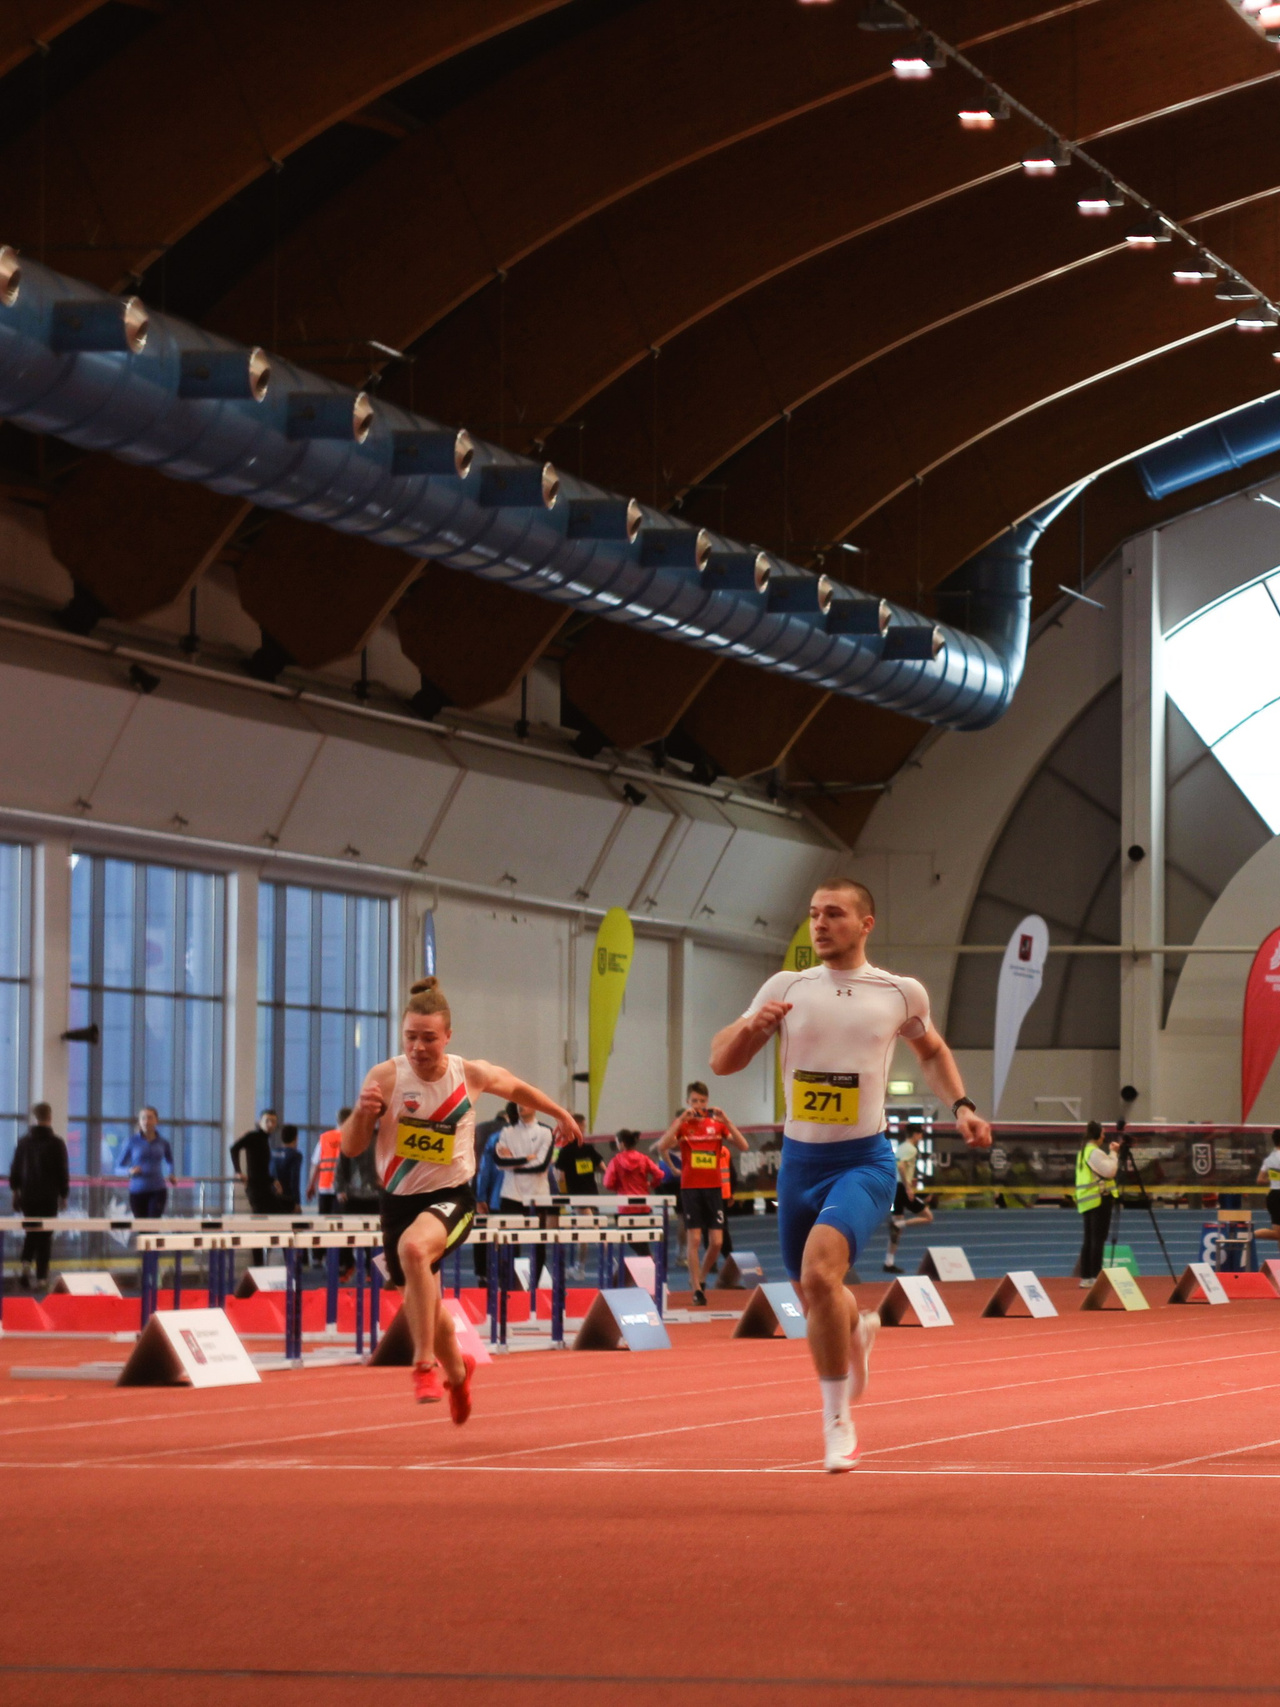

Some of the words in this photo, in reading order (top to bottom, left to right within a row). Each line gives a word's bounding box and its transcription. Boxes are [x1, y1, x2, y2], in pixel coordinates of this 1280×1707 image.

[804, 1090, 842, 1112] 271
[403, 1133, 445, 1154] 464
[1202, 1232, 1227, 1267] 8
